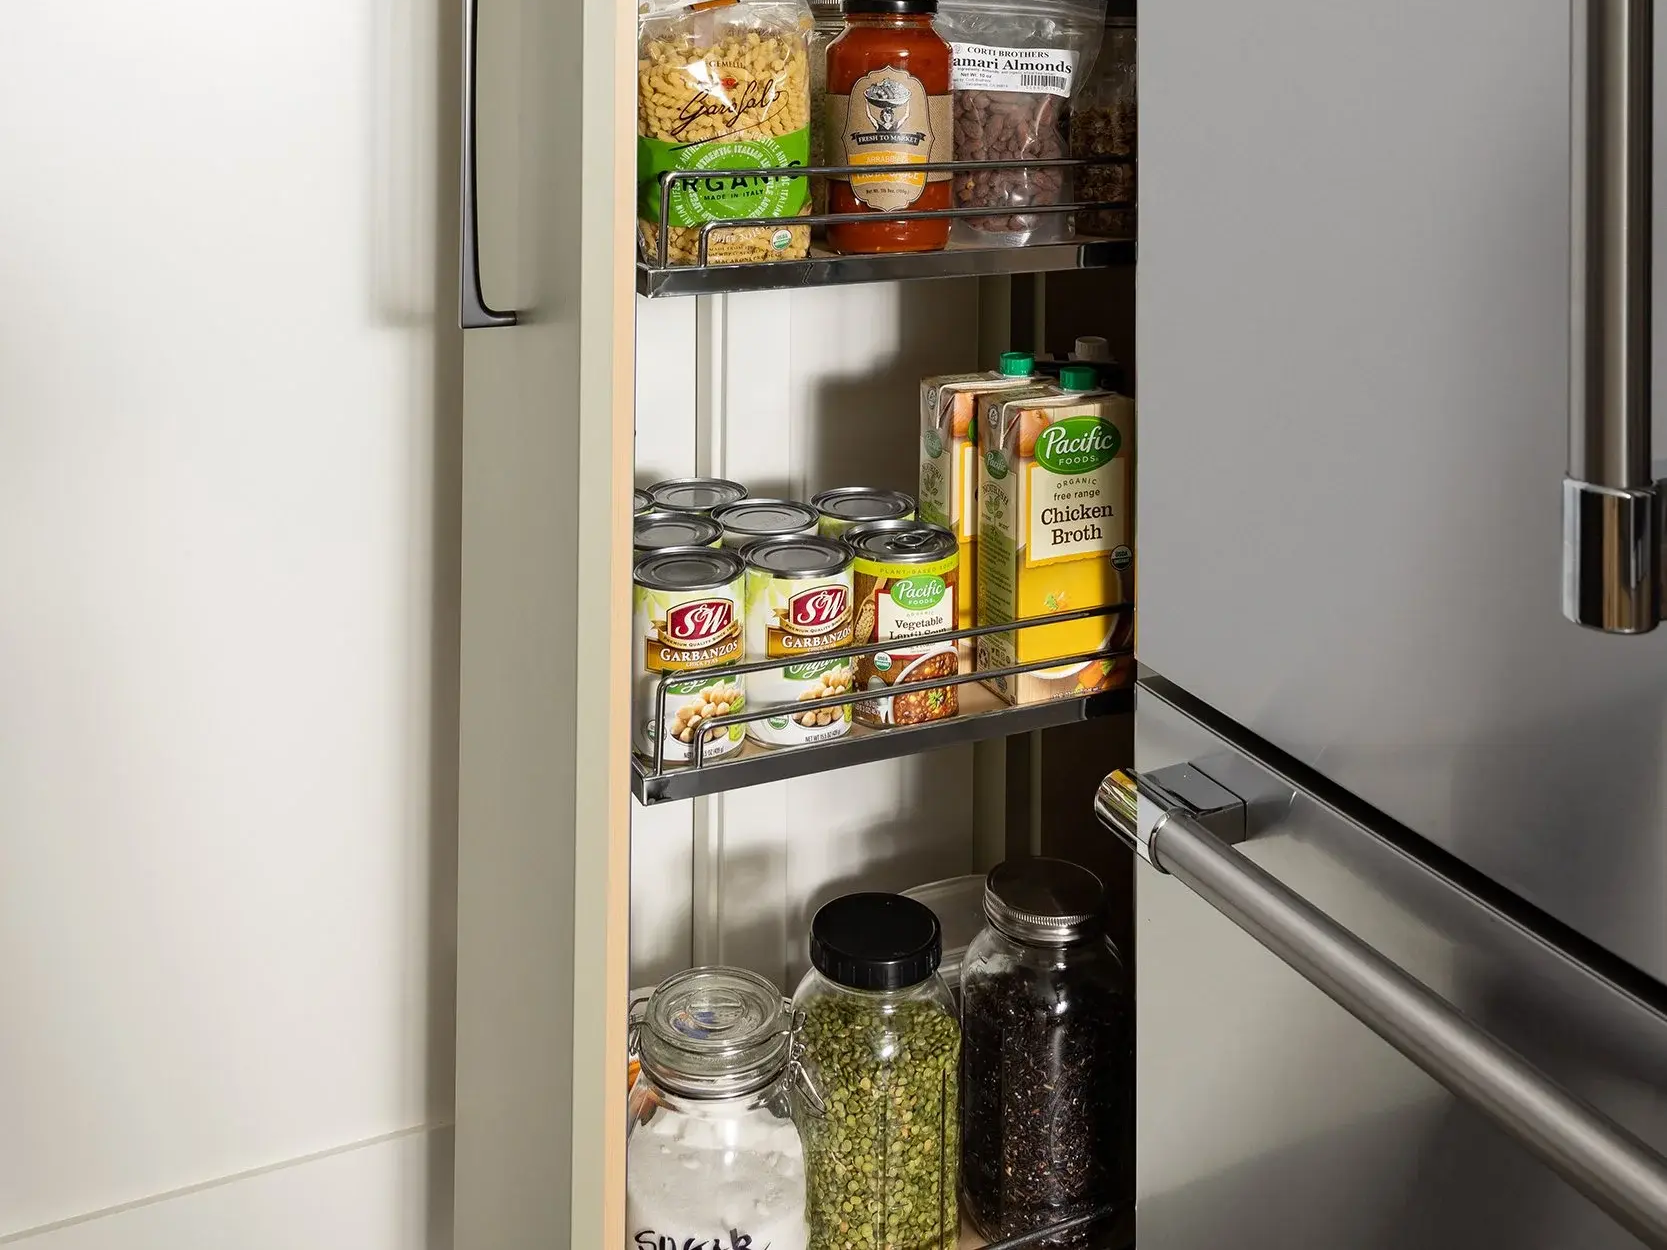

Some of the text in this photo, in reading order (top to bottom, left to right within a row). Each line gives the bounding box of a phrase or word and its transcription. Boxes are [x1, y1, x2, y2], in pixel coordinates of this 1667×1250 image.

[967, 46, 1049, 58] CORTI BROTHERS
[953, 58, 1072, 74] amari Almonds
[890, 135, 918, 143] MARKET
[704, 188, 764, 200] MADE IN ITALY
[1043, 425, 1113, 459] Pacific
[1059, 455, 1096, 465] FOODS
[1056, 477, 1098, 489] ORGANIC
[1053, 489, 1101, 501] free range
[1041, 504, 1114, 525] Chicken
[1051, 524, 1103, 545] Broth
[880, 567, 936, 575] PLANT-BASED
[896, 579, 942, 600] Pacific
[895, 616, 943, 631] Vegetable
[689, 639, 711, 648] QUALITY
